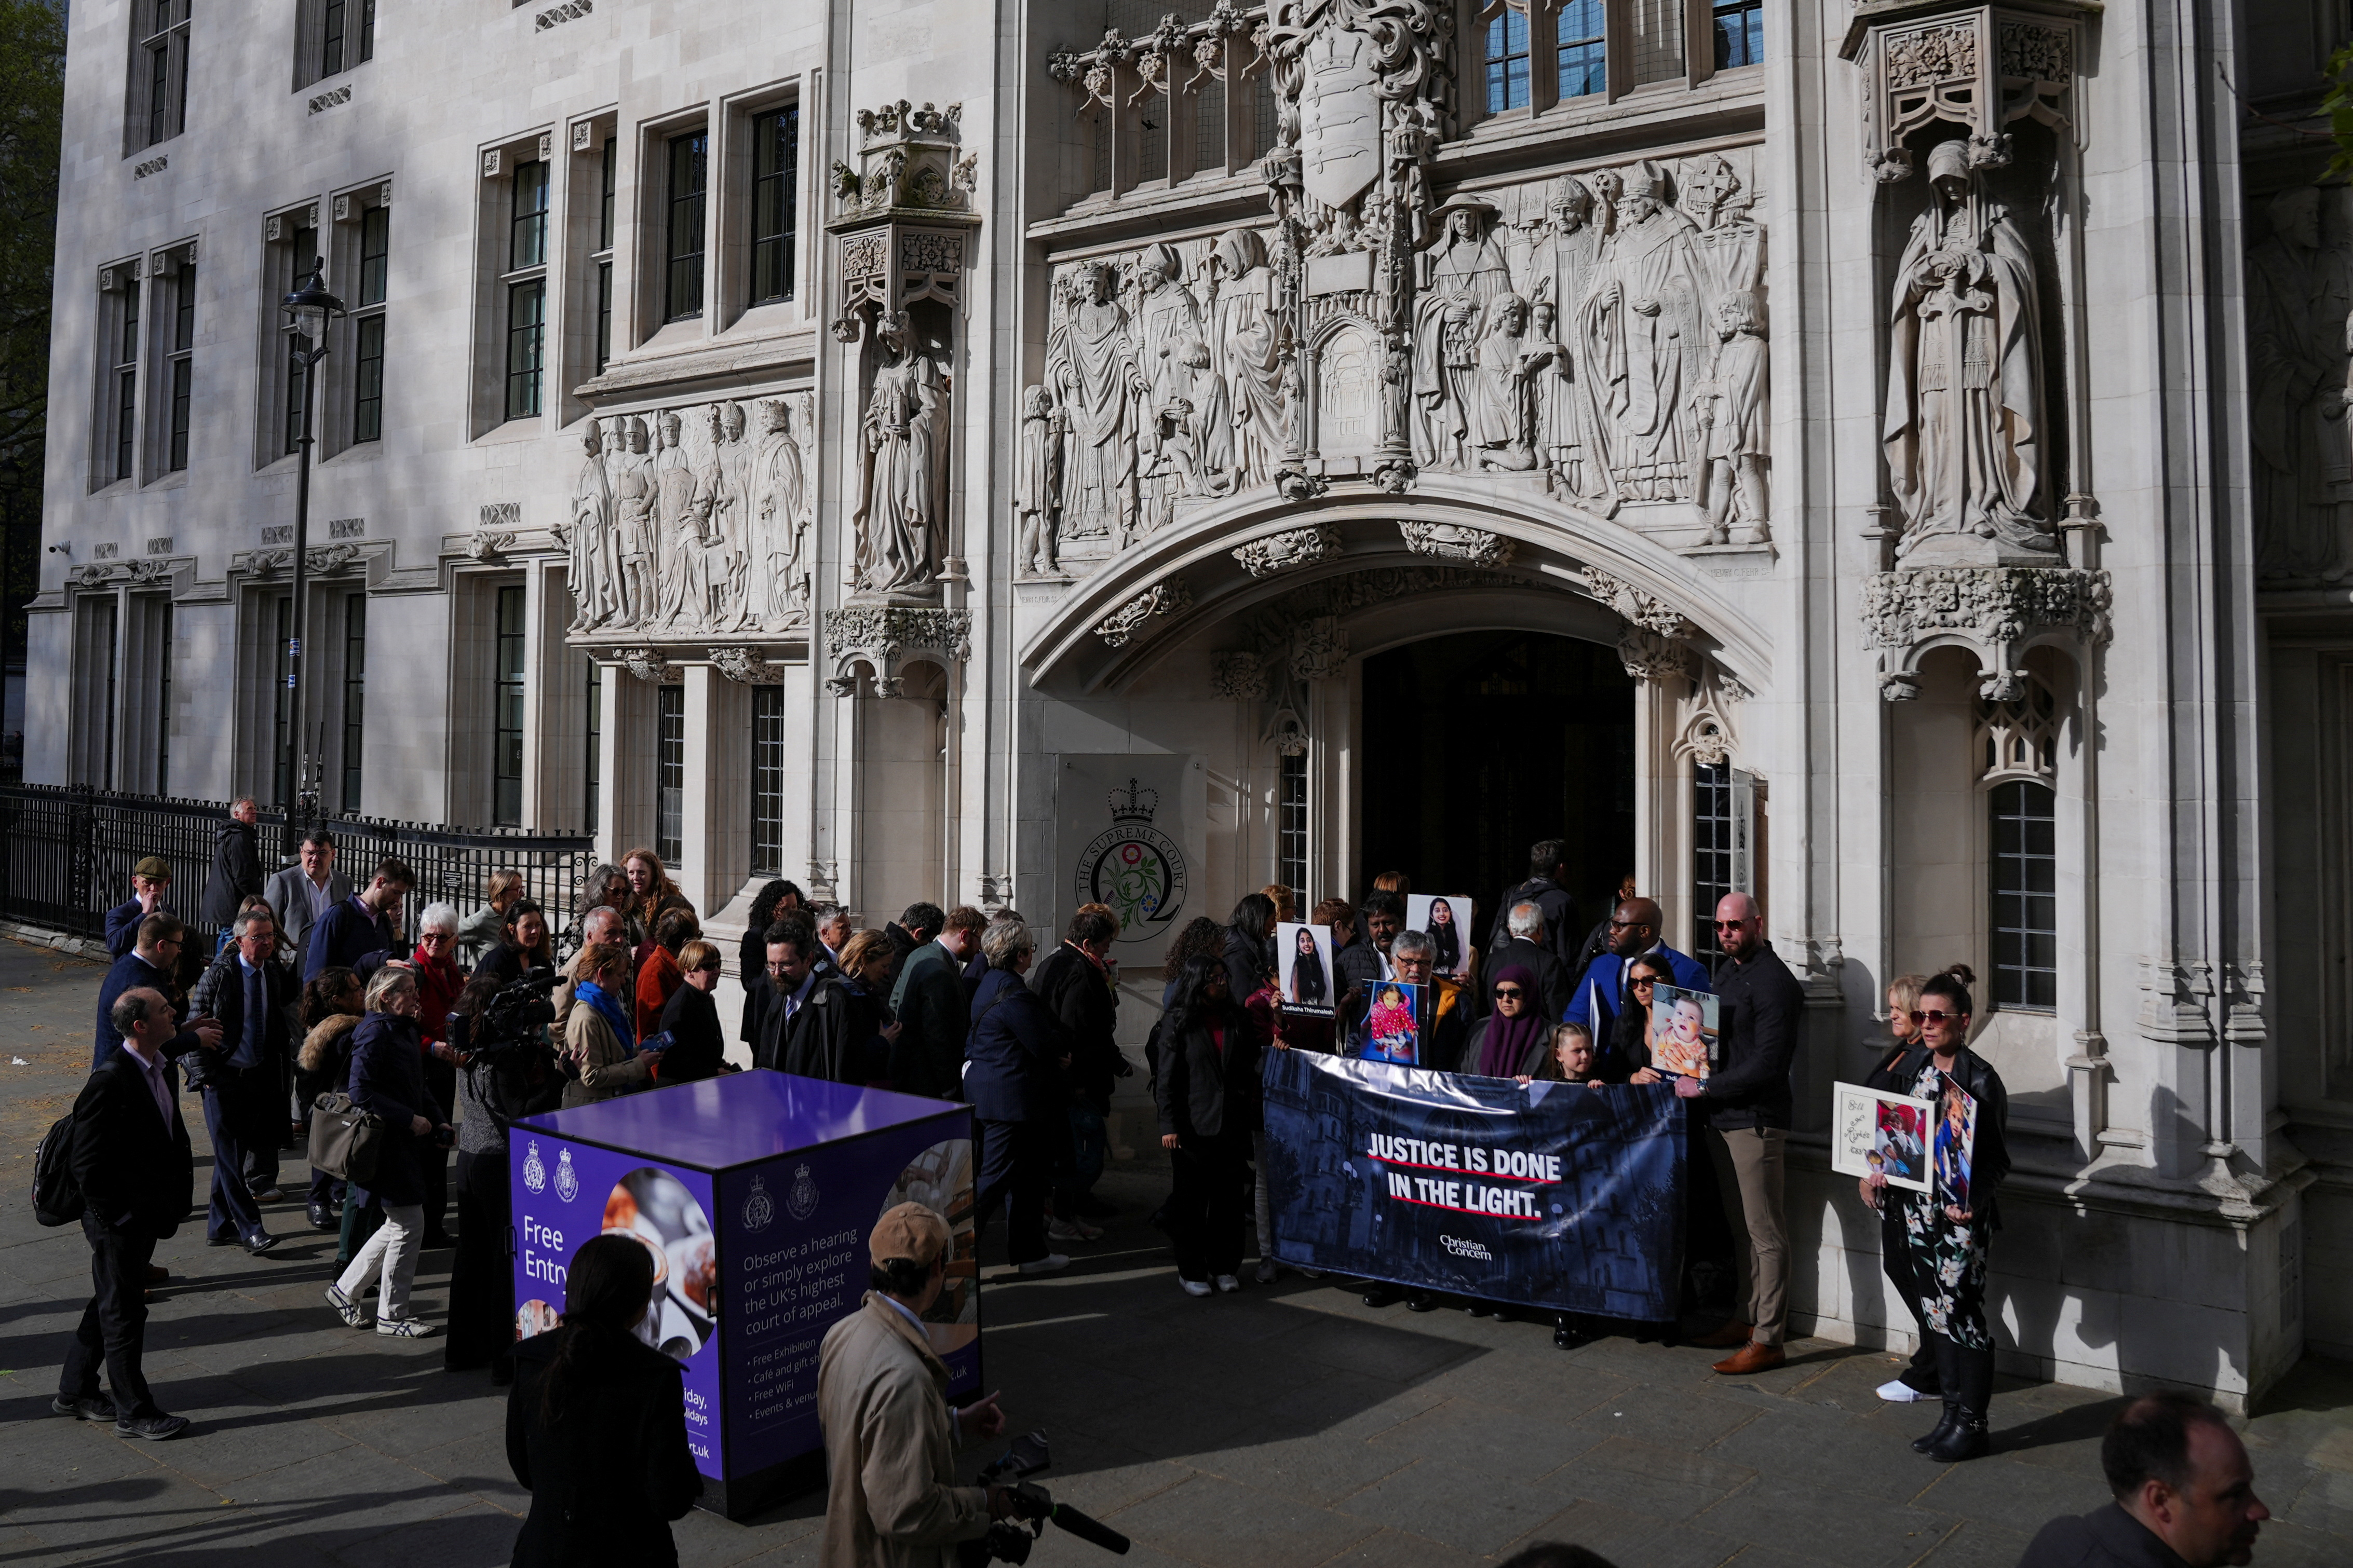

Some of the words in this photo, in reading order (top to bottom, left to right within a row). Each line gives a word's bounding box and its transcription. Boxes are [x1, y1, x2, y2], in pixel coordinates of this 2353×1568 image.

[1079, 860, 1093, 893] THE
[1090, 827, 1157, 857] SUPREME
[1159, 840, 1184, 892] COURT
[1304, 1007, 1334, 1015] Thirumalesh
[1848, 1099, 1864, 1111] Bill
[1850, 1114, 1865, 1126] of
[1844, 1127, 1870, 1143] Rights
[1368, 1133, 1459, 1169] JUSTICE
[1464, 1146, 1487, 1172] IS
[1494, 1149, 1562, 1181] DONE
[1388, 1171, 1411, 1199] IN
[1415, 1178, 1459, 1208] THE
[1465, 1184, 1541, 1217] LIGHT.
[524, 1215, 563, 1252] Free
[1439, 1234, 1486, 1252] Christian
[743, 1246, 797, 1271] Observe
[801, 1244, 808, 1255] a
[812, 1228, 858, 1252] hearing
[1446, 1244, 1492, 1261] Concern
[744, 1278, 759, 1293] or
[762, 1264, 803, 1288] simply
[807, 1250, 852, 1274] explore
[745, 1297, 766, 1315] the
[800, 1272, 845, 1298] highest
[746, 1313, 780, 1335] court
[783, 1305, 796, 1324] of
[800, 1291, 844, 1320] appeal.
[753, 1353, 772, 1367] Free
[774, 1338, 816, 1359] Exhibition
[753, 1368, 774, 1384] Café
[776, 1362, 792, 1377] and
[794, 1356, 808, 1373] gift
[684, 1387, 707, 1410] iday,
[754, 1388, 774, 1402] Free
[776, 1379, 794, 1395] WiFi
[755, 1401, 784, 1420] Events
[786, 1398, 793, 1409] &
